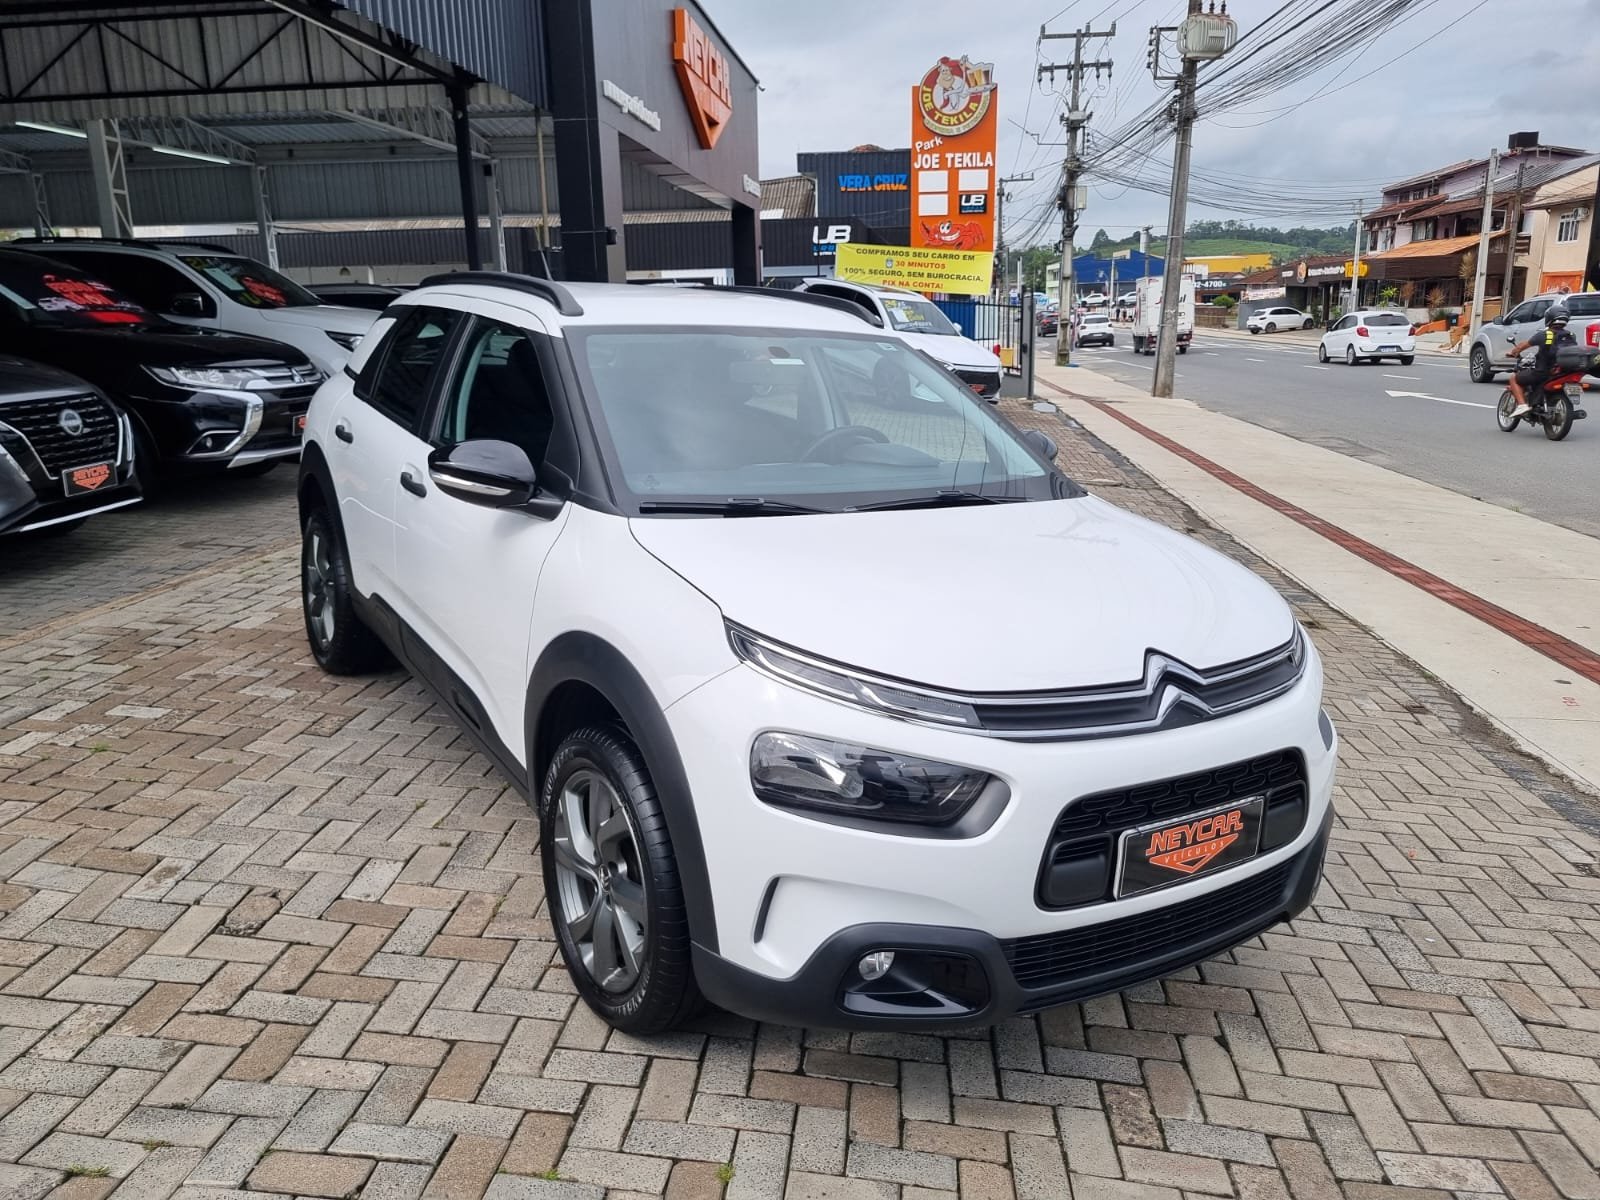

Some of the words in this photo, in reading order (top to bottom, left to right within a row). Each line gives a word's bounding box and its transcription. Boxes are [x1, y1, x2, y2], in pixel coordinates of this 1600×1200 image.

[677, 8, 732, 109] NEYCAR
[922, 86, 934, 111] JOE
[933, 102, 978, 126] TEKILA
[915, 136, 943, 152] Park
[914, 153, 940, 169] JOE
[945, 152, 993, 168] TEKILA
[838, 174, 871, 191] VERA
[873, 174, 908, 191] CRUZ
[856, 248, 910, 258] COMPRAMOS
[912, 250, 929, 259] SEU
[931, 251, 960, 260] CARRO
[962, 253, 975, 261] EM
[908, 261, 946, 269] MINUTOS
[844, 267, 866, 275] 100%
[868, 268, 905, 278] SEGURO,
[907, 271, 925, 279] SEM
[927, 272, 984, 282] BUROCRACIA.
[882, 279, 896, 287] PIX
[899, 280, 911, 288] NA
[913, 281, 944, 289] CONTA!
[1145, 810, 1244, 857] NEYCAR
